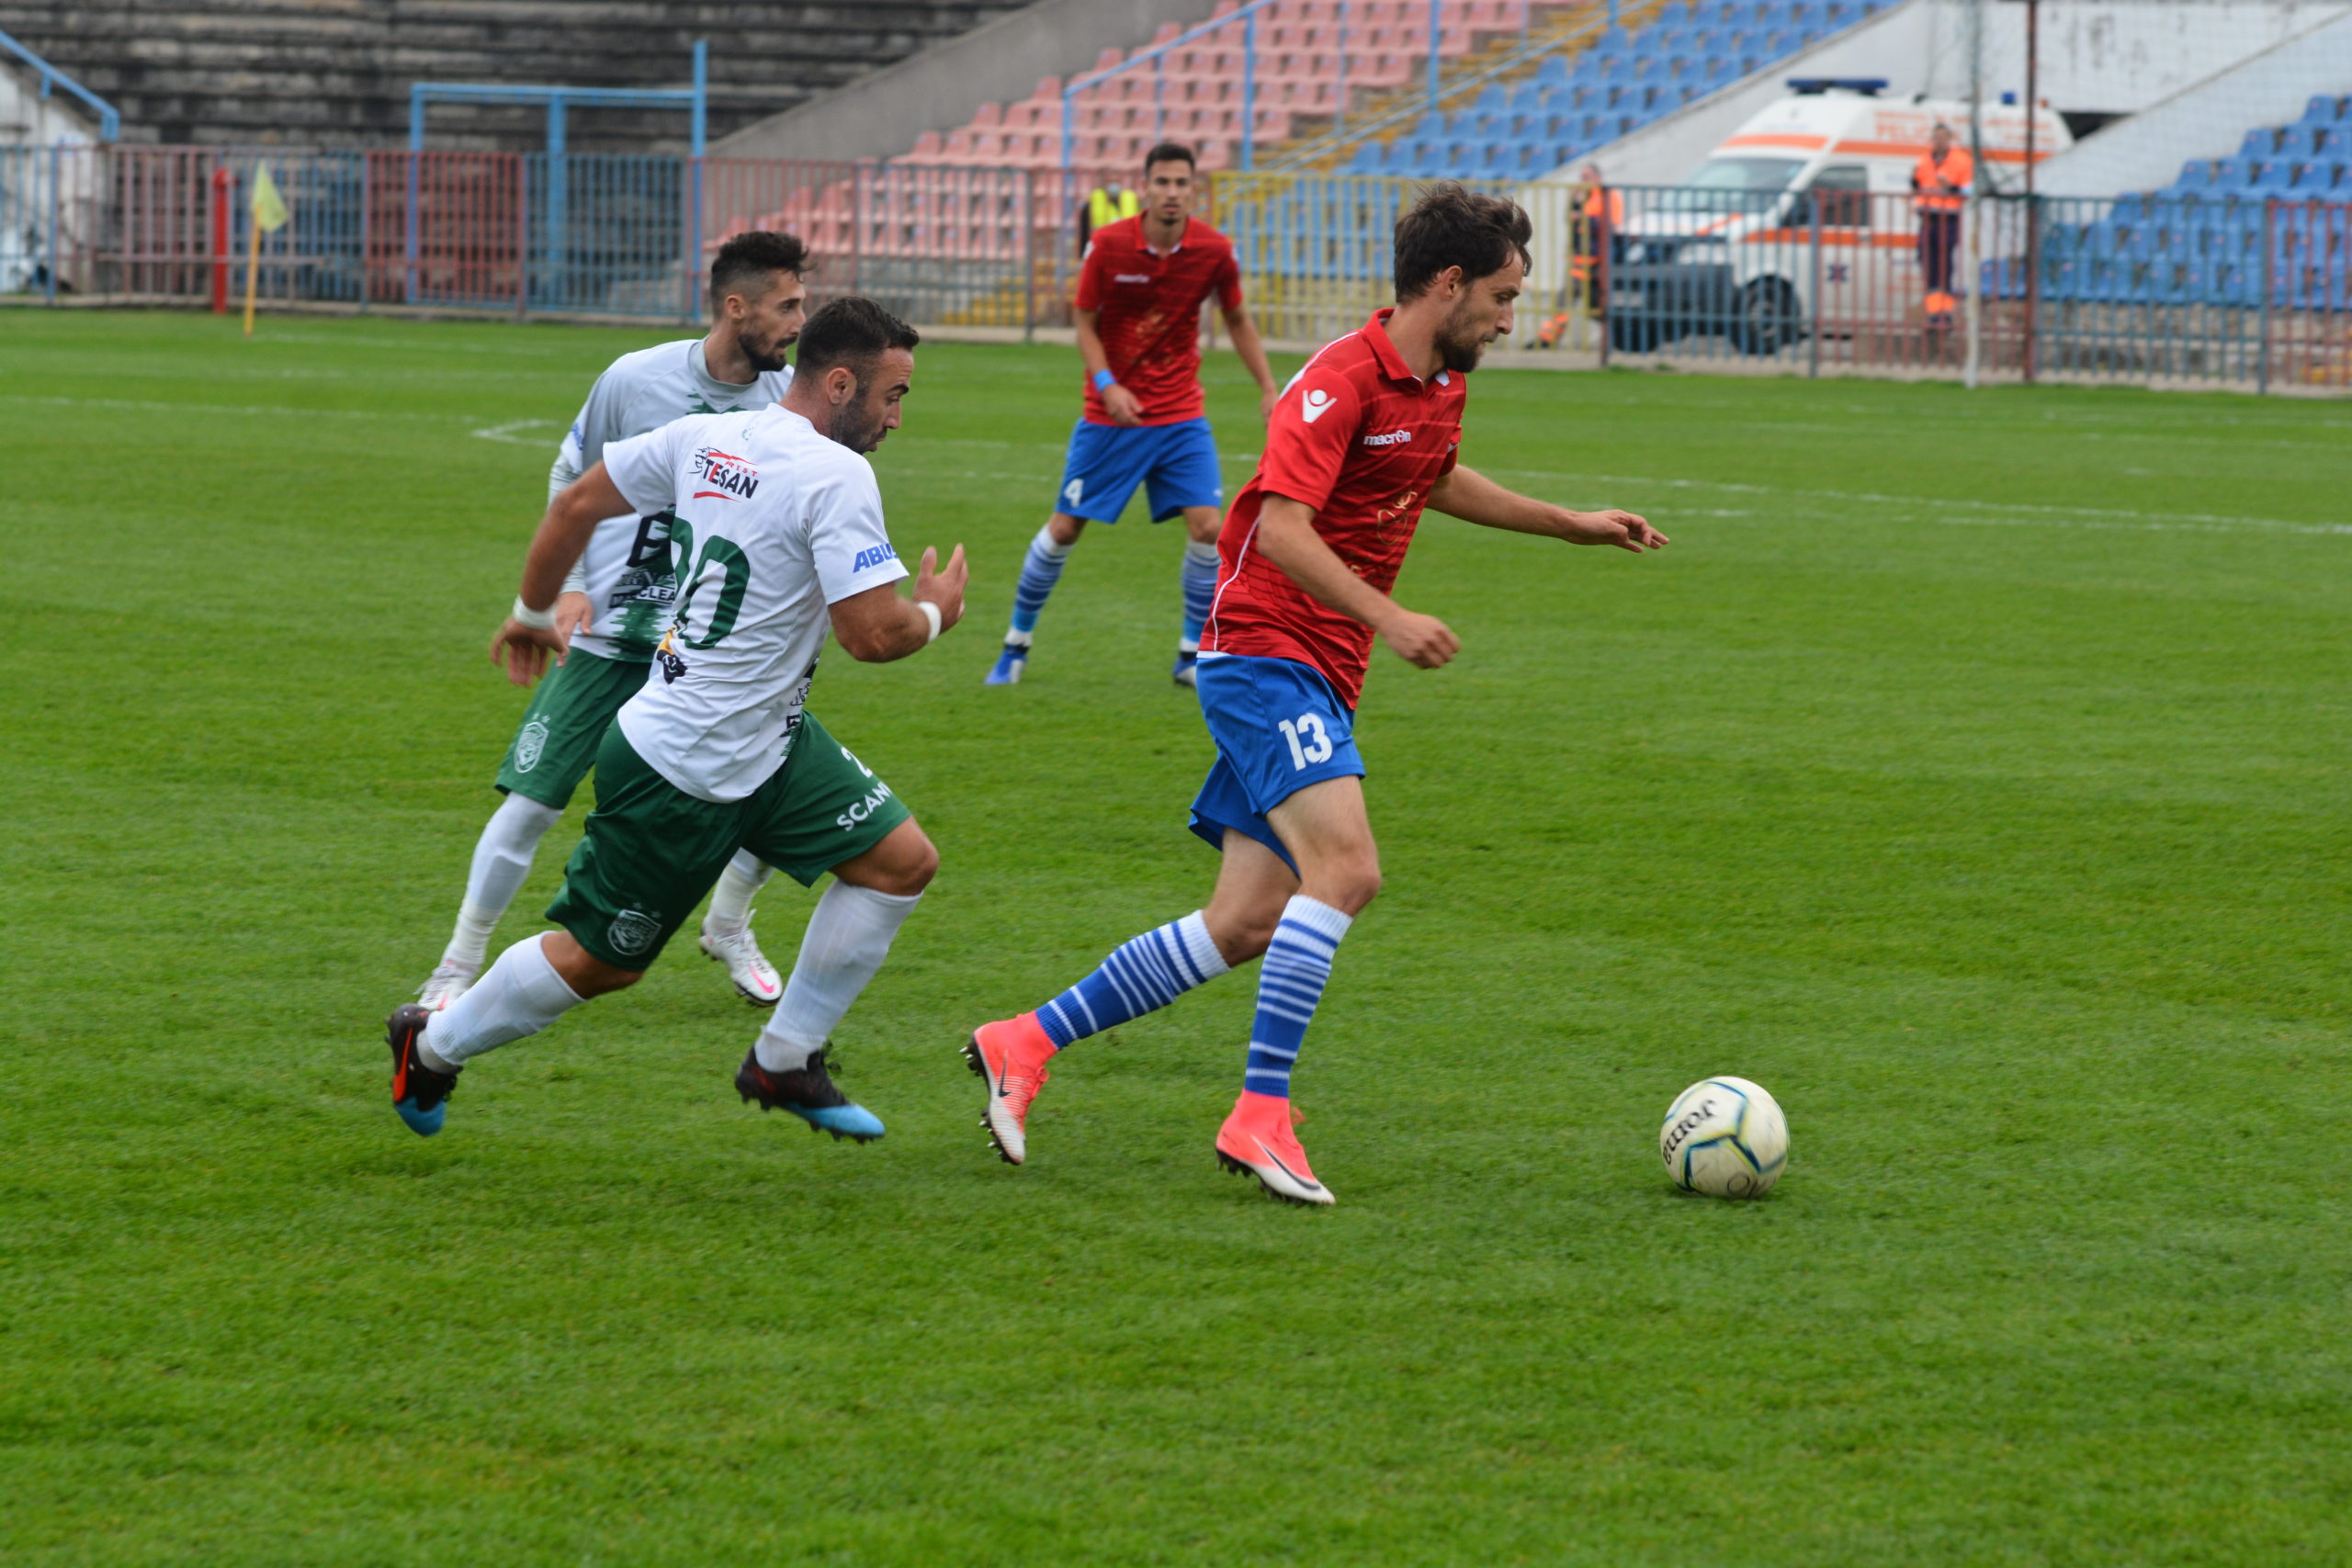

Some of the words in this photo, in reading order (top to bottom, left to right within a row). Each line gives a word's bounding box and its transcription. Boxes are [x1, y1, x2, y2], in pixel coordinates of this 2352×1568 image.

[1363, 429, 1411, 446] macron
[703, 458, 759, 499] TESAN
[1064, 478, 1084, 508] 4
[1278, 712, 1333, 772] 13
